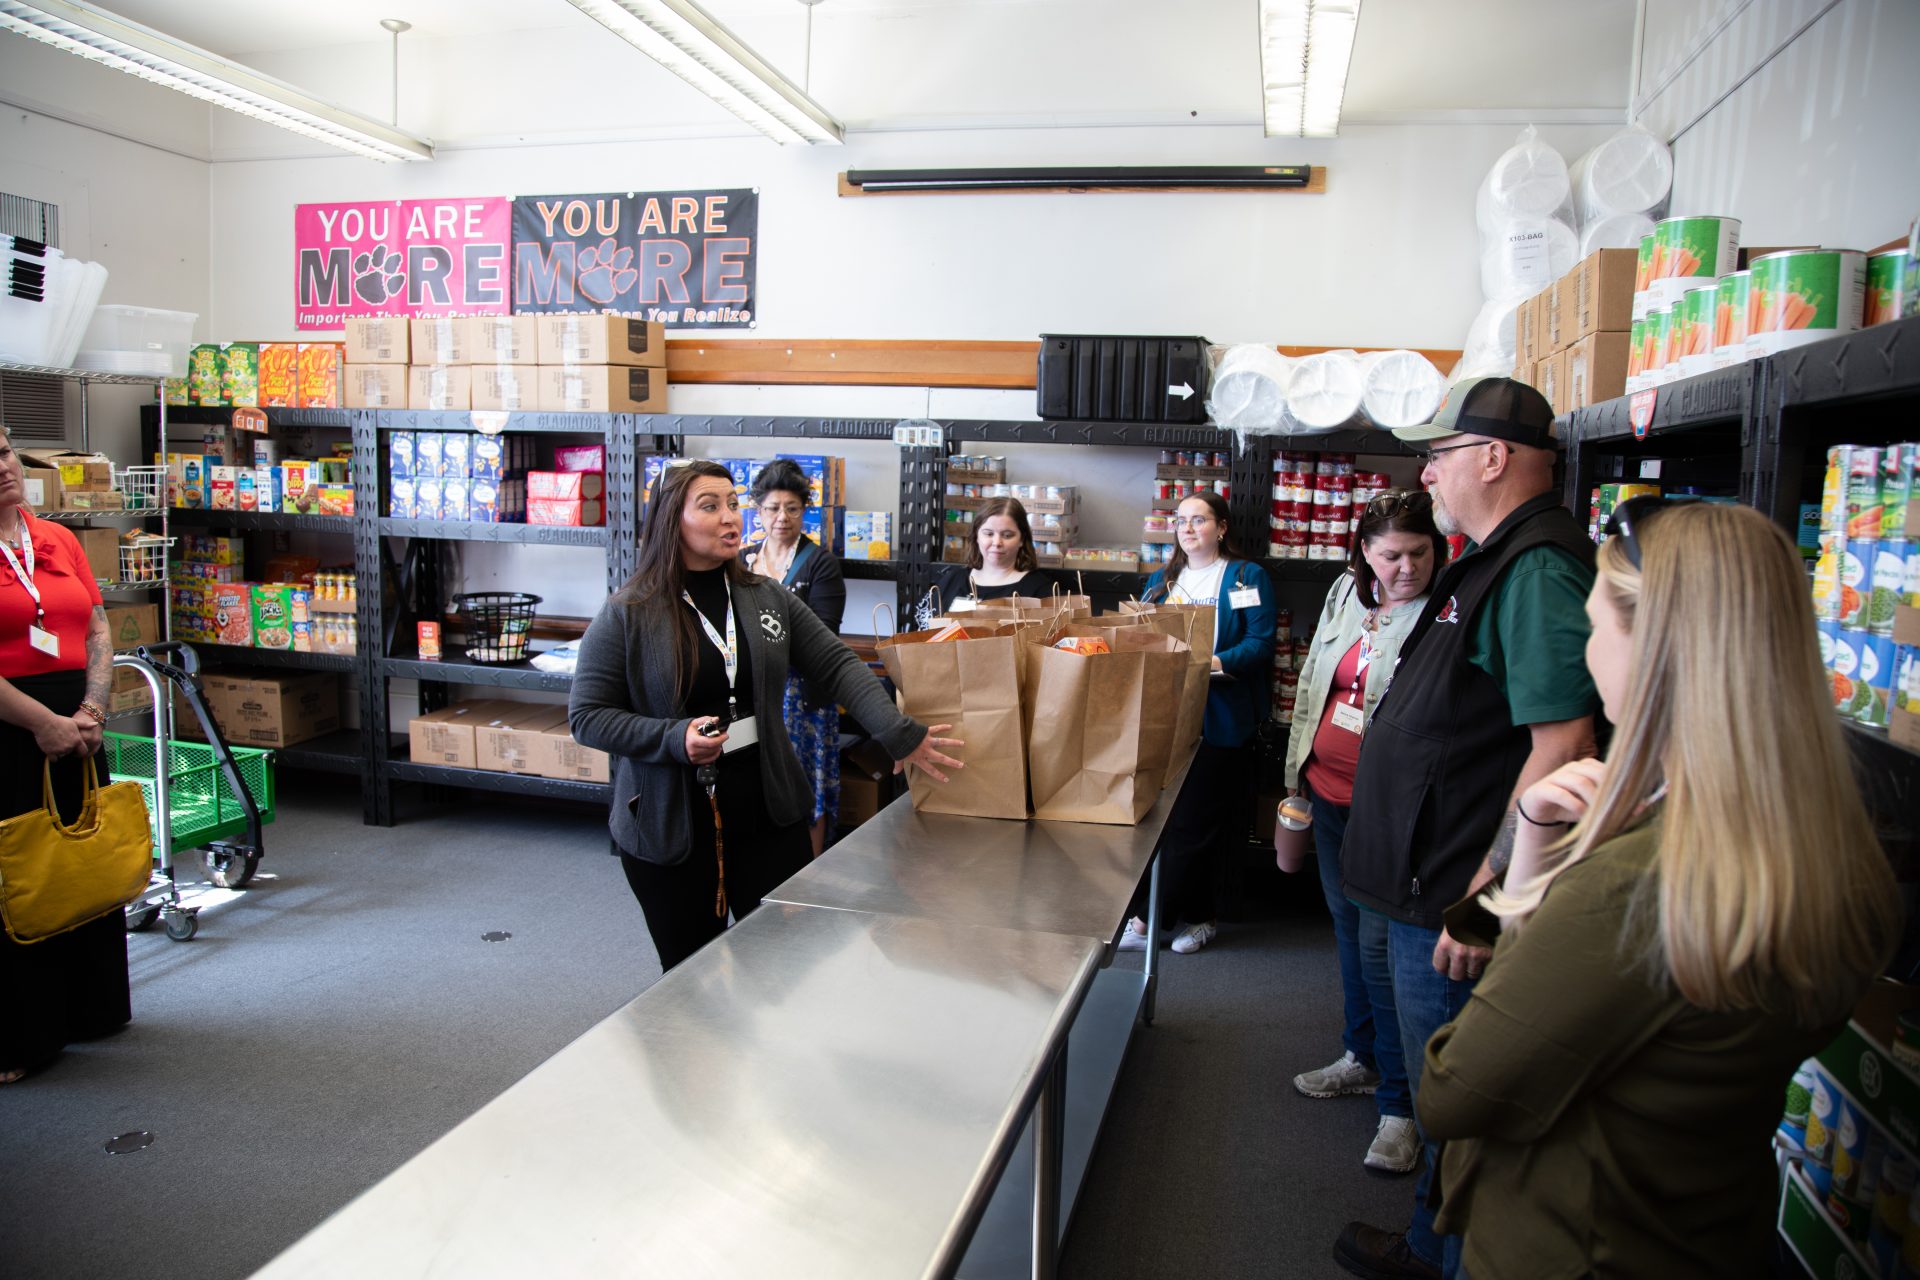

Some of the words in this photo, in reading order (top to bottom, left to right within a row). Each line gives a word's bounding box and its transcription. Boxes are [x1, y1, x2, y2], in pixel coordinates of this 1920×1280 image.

[317, 207, 389, 242] YOU
[405, 204, 484, 240] ARE
[537, 199, 620, 238] YOU
[637, 195, 729, 235] ARE
[647, 308, 679, 323] You
[683, 306, 751, 323] Realize
[537, 414, 601, 430] GLADIATOR
[537, 529, 603, 545] GLADIATOR
